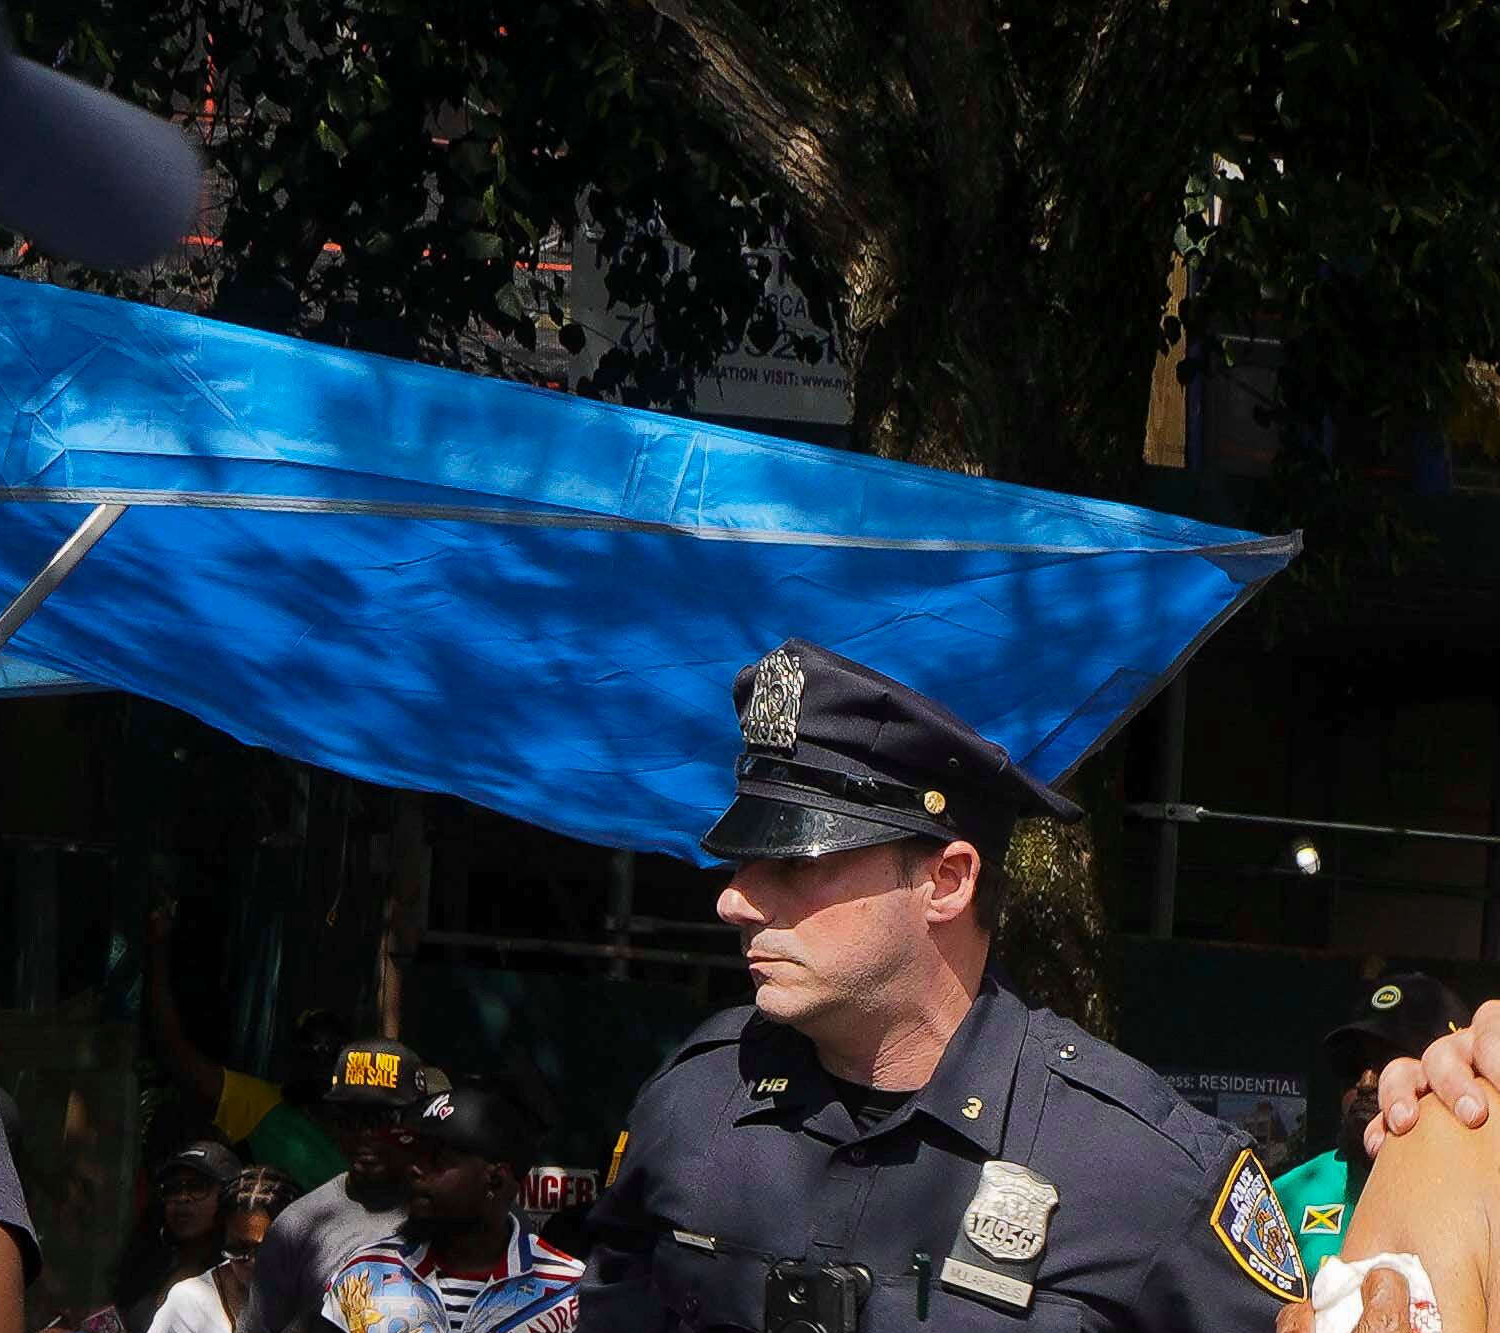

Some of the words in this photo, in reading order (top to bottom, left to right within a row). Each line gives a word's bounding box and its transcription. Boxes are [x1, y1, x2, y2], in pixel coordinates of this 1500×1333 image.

[375, 1052, 401, 1074] NOT
[344, 1063, 365, 1086] FOR
[367, 1067, 398, 1089] SALE
[757, 1078, 789, 1093] HB
[1199, 1074, 1301, 1096] RESIDENTIAL
[961, 1096, 983, 1120] 3
[517, 1174, 595, 1208] NGER
